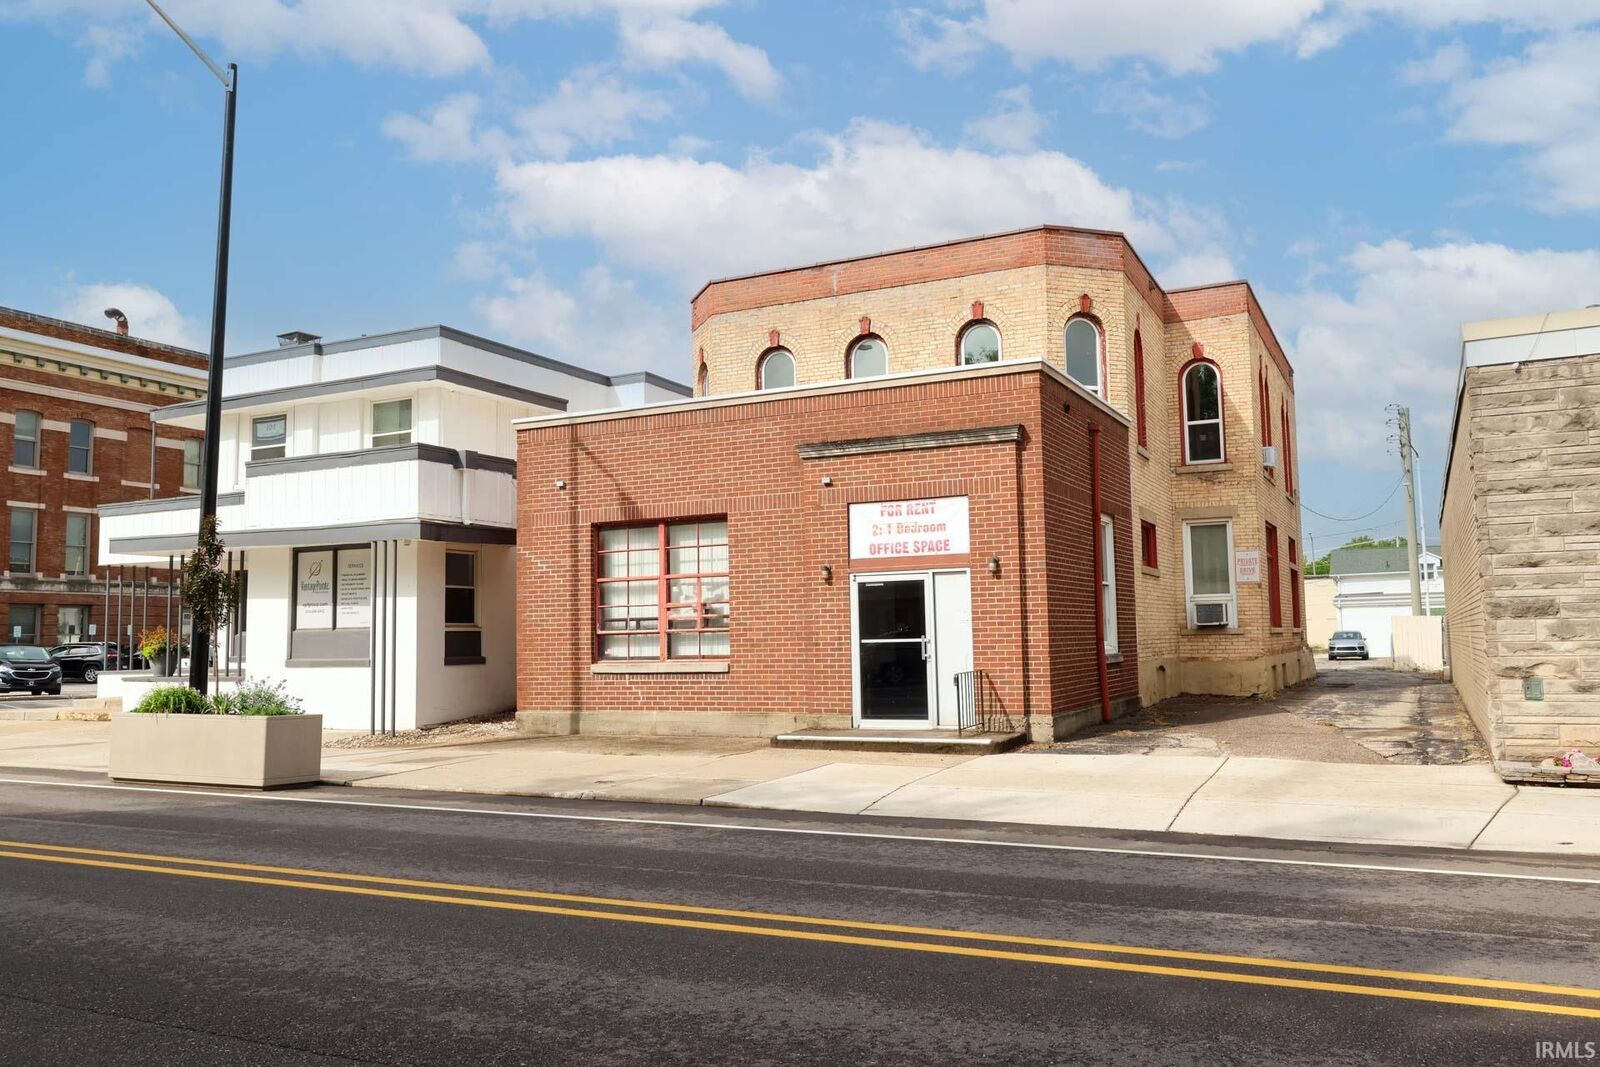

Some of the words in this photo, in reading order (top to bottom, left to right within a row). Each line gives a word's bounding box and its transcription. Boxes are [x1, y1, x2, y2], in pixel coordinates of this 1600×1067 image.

[880, 503, 903, 517] FOR
[906, 501, 937, 516] RENT
[896, 522, 947, 535] Bedroom
[869, 541, 910, 556] OFFICE
[912, 539, 951, 553] SPACE
